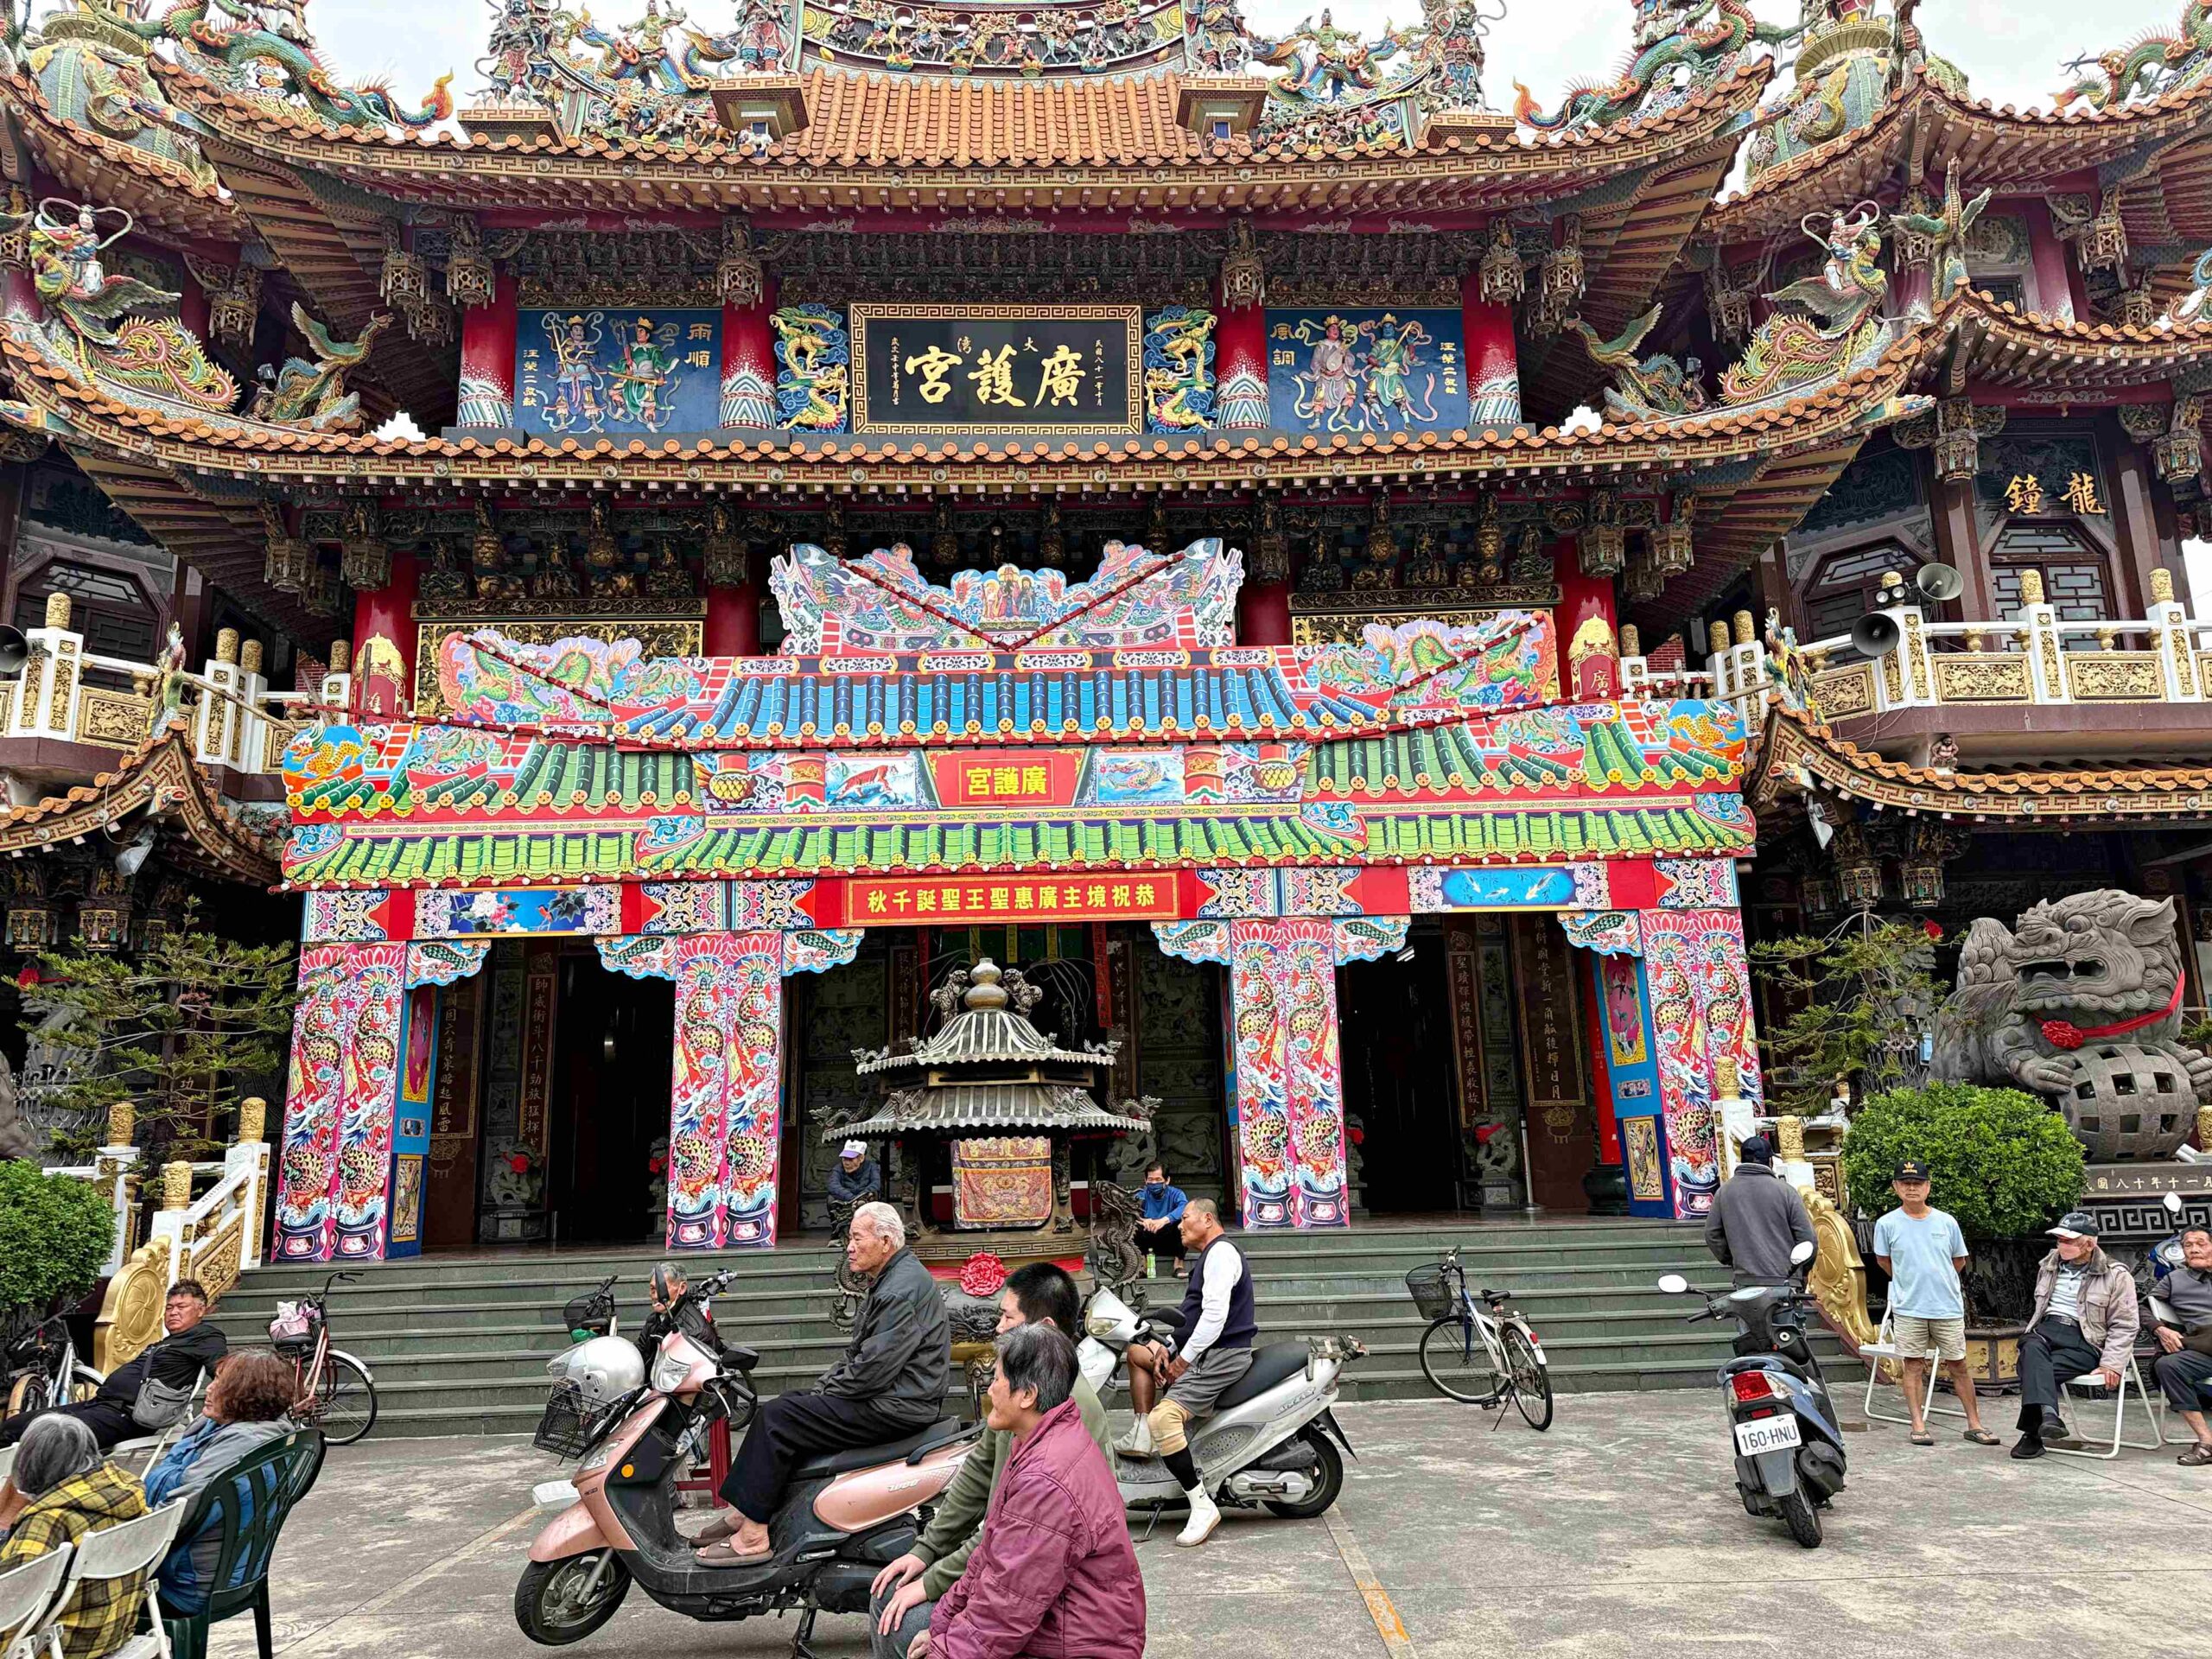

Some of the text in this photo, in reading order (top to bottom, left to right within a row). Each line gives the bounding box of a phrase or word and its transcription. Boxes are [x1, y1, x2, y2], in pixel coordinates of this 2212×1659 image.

[683, 322, 713, 368] 雨順
[1270, 322, 1295, 366] 風調
[905, 343, 1086, 408] 廣護宮
[2004, 472, 2107, 515] 龍鐘
[966, 766, 1047, 797] 廣護宮
[868, 883, 1156, 914] 恭祝境主廣惠聖王聖誕千秋
